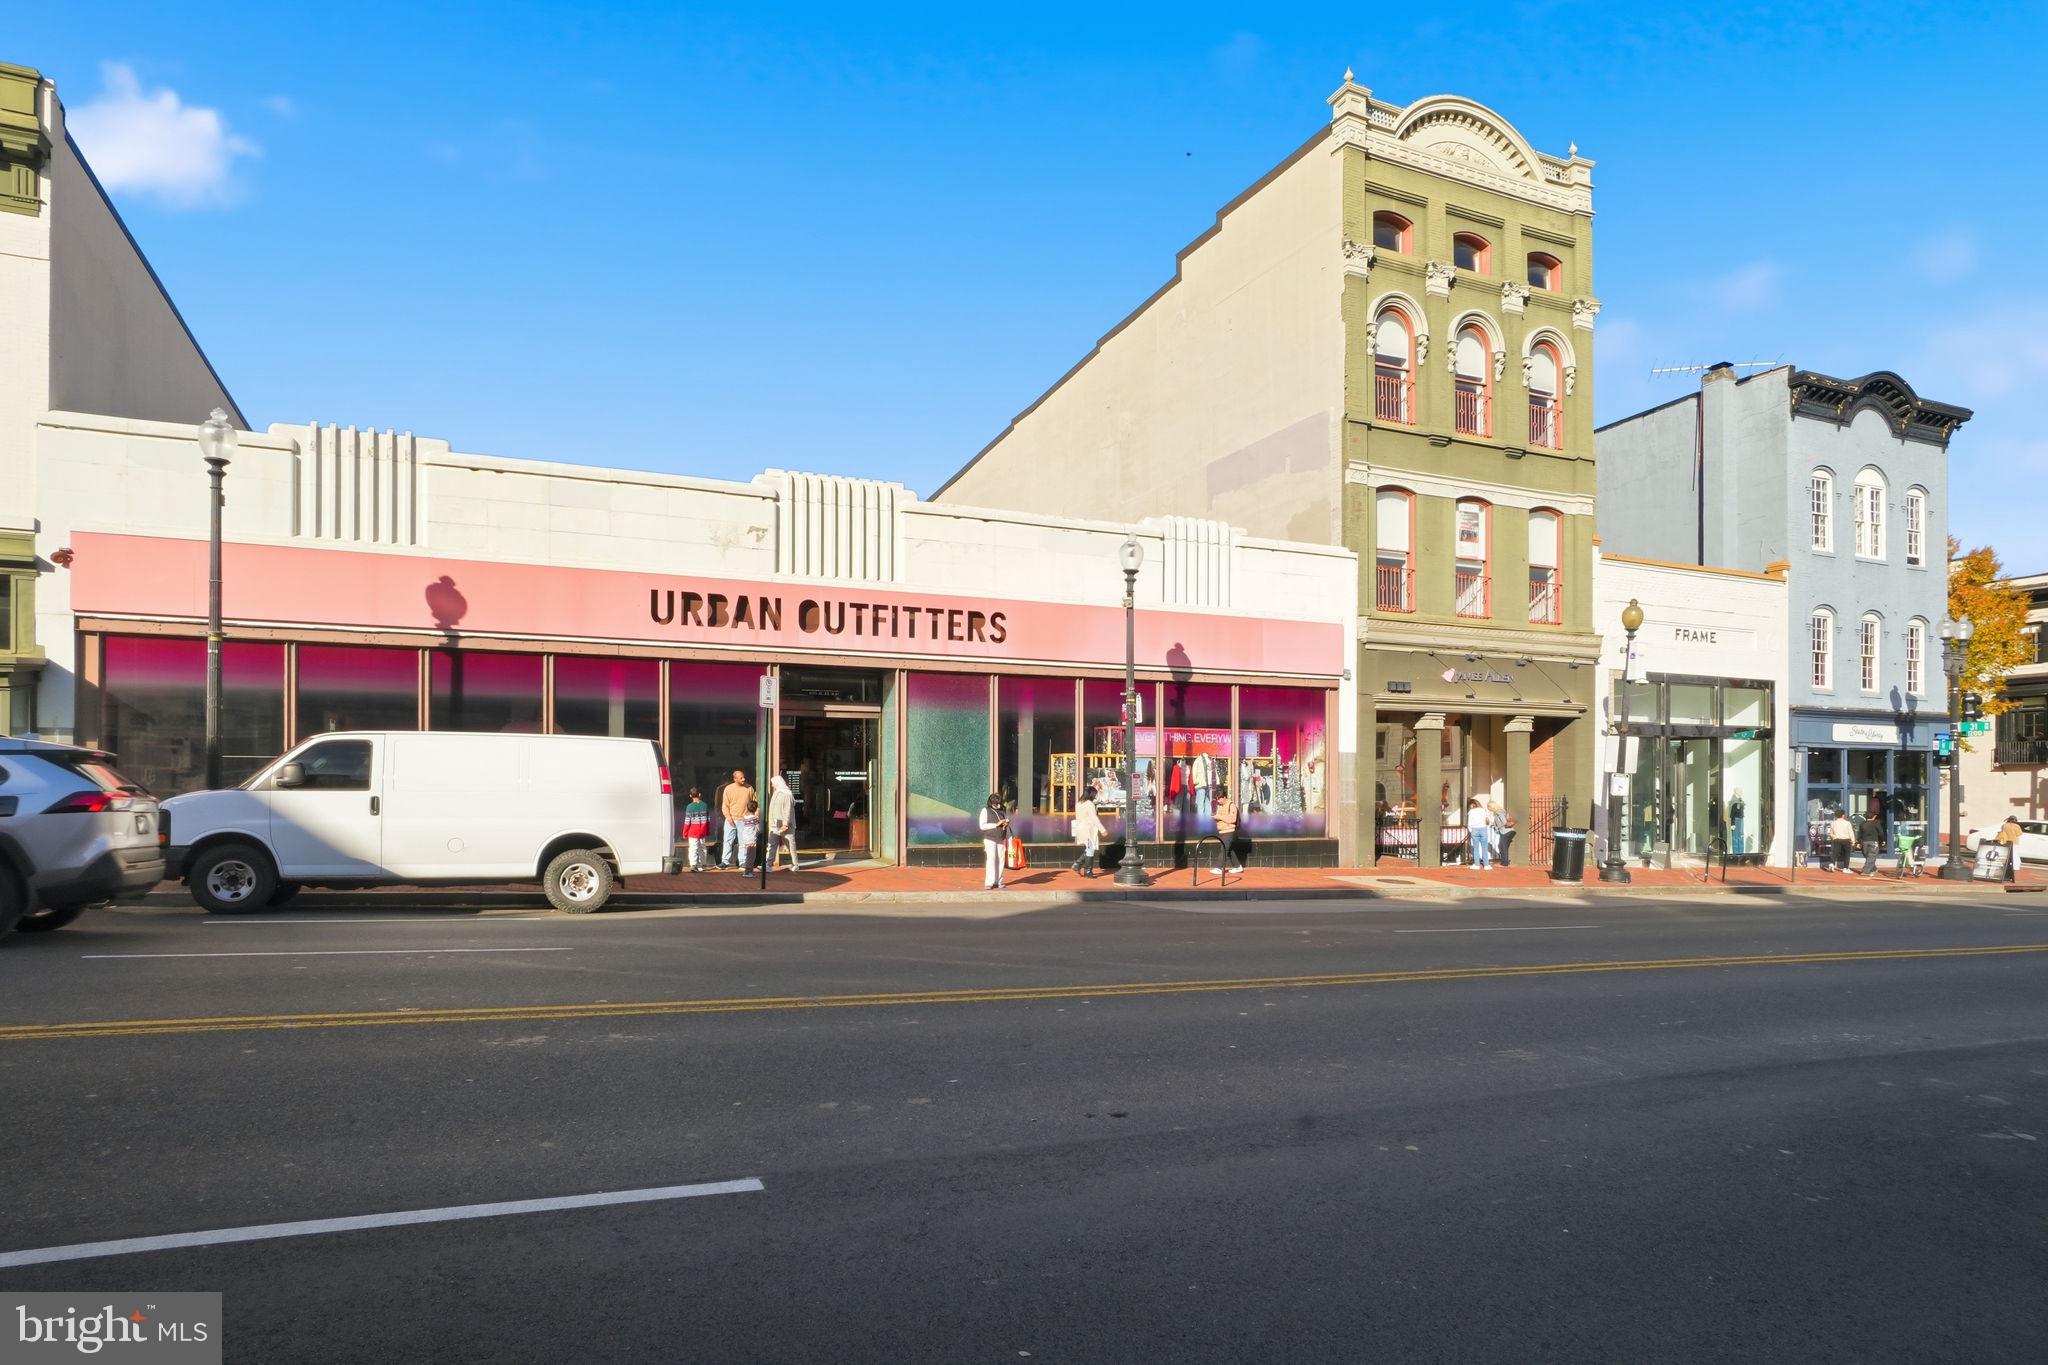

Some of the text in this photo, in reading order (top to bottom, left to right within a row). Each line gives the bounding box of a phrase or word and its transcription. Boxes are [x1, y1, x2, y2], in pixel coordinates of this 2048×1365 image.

[651, 589, 1006, 643] URBAN OUTFITTERS
[1675, 629, 1716, 643] FRAME
